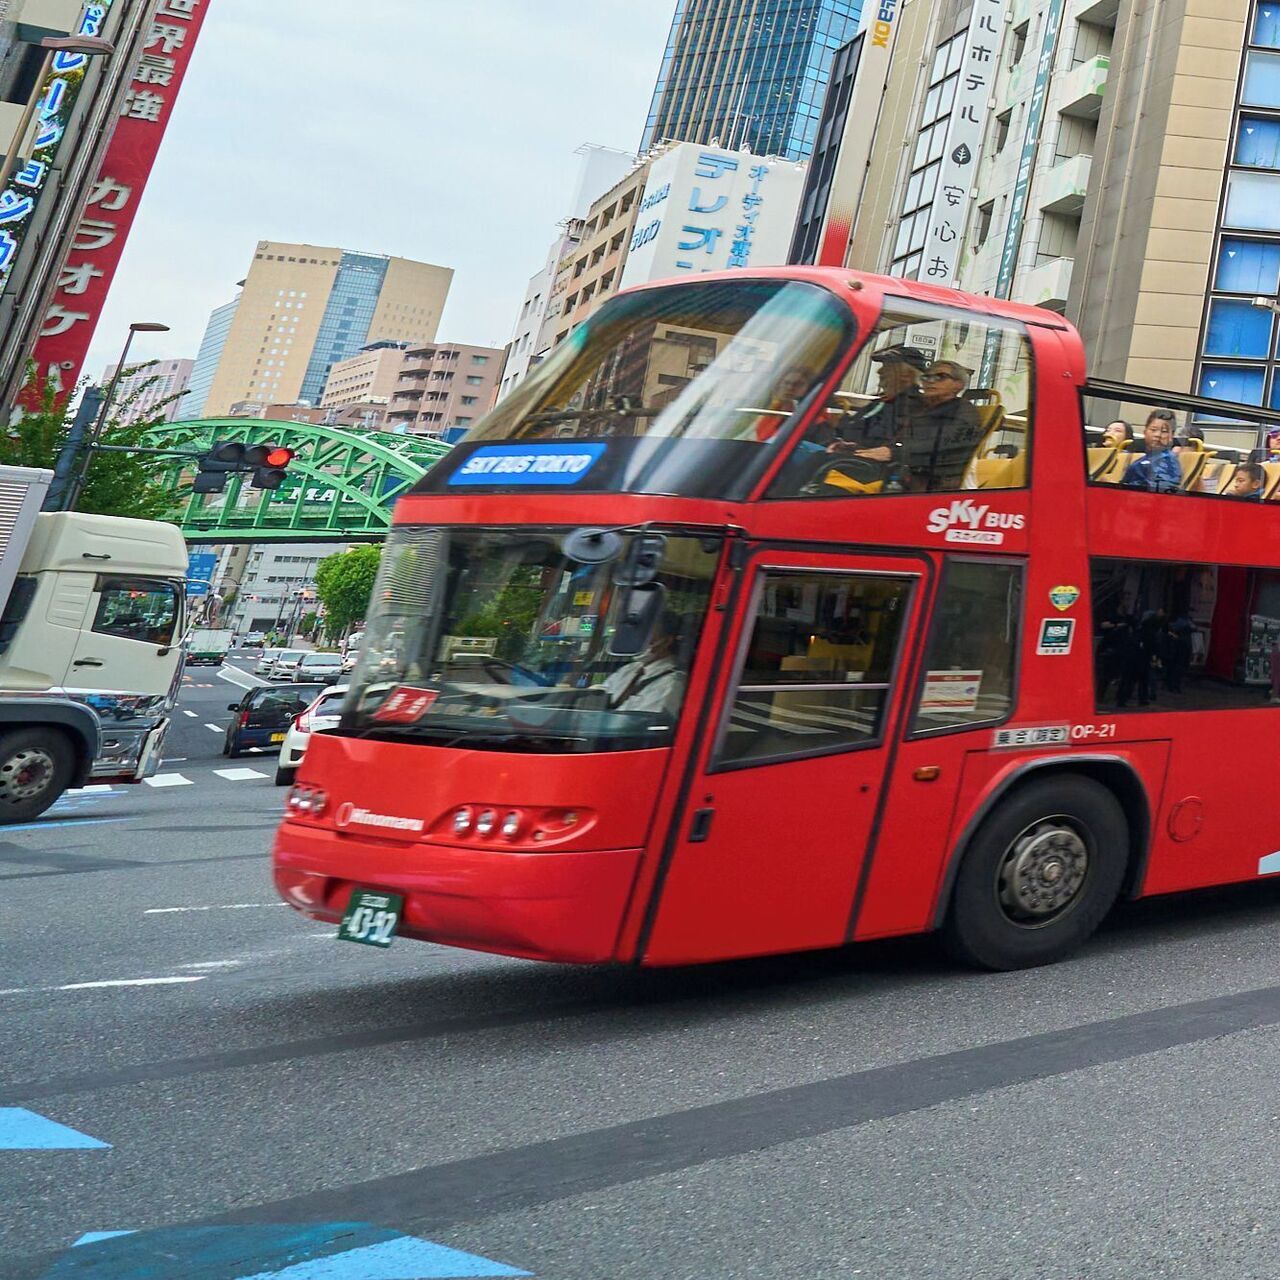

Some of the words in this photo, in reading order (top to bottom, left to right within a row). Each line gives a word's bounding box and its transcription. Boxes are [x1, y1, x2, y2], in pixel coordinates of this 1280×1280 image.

[675, 152, 740, 272] テレオ
[927, 183, 965, 279] 安心お
[461, 456, 497, 474] SKY
[496, 455, 531, 473] BUS
[529, 454, 593, 473] TOKYO
[926, 499, 989, 533] SKY
[985, 514, 1025, 530] BUS
[1071, 724, 1116, 739] OP-21
